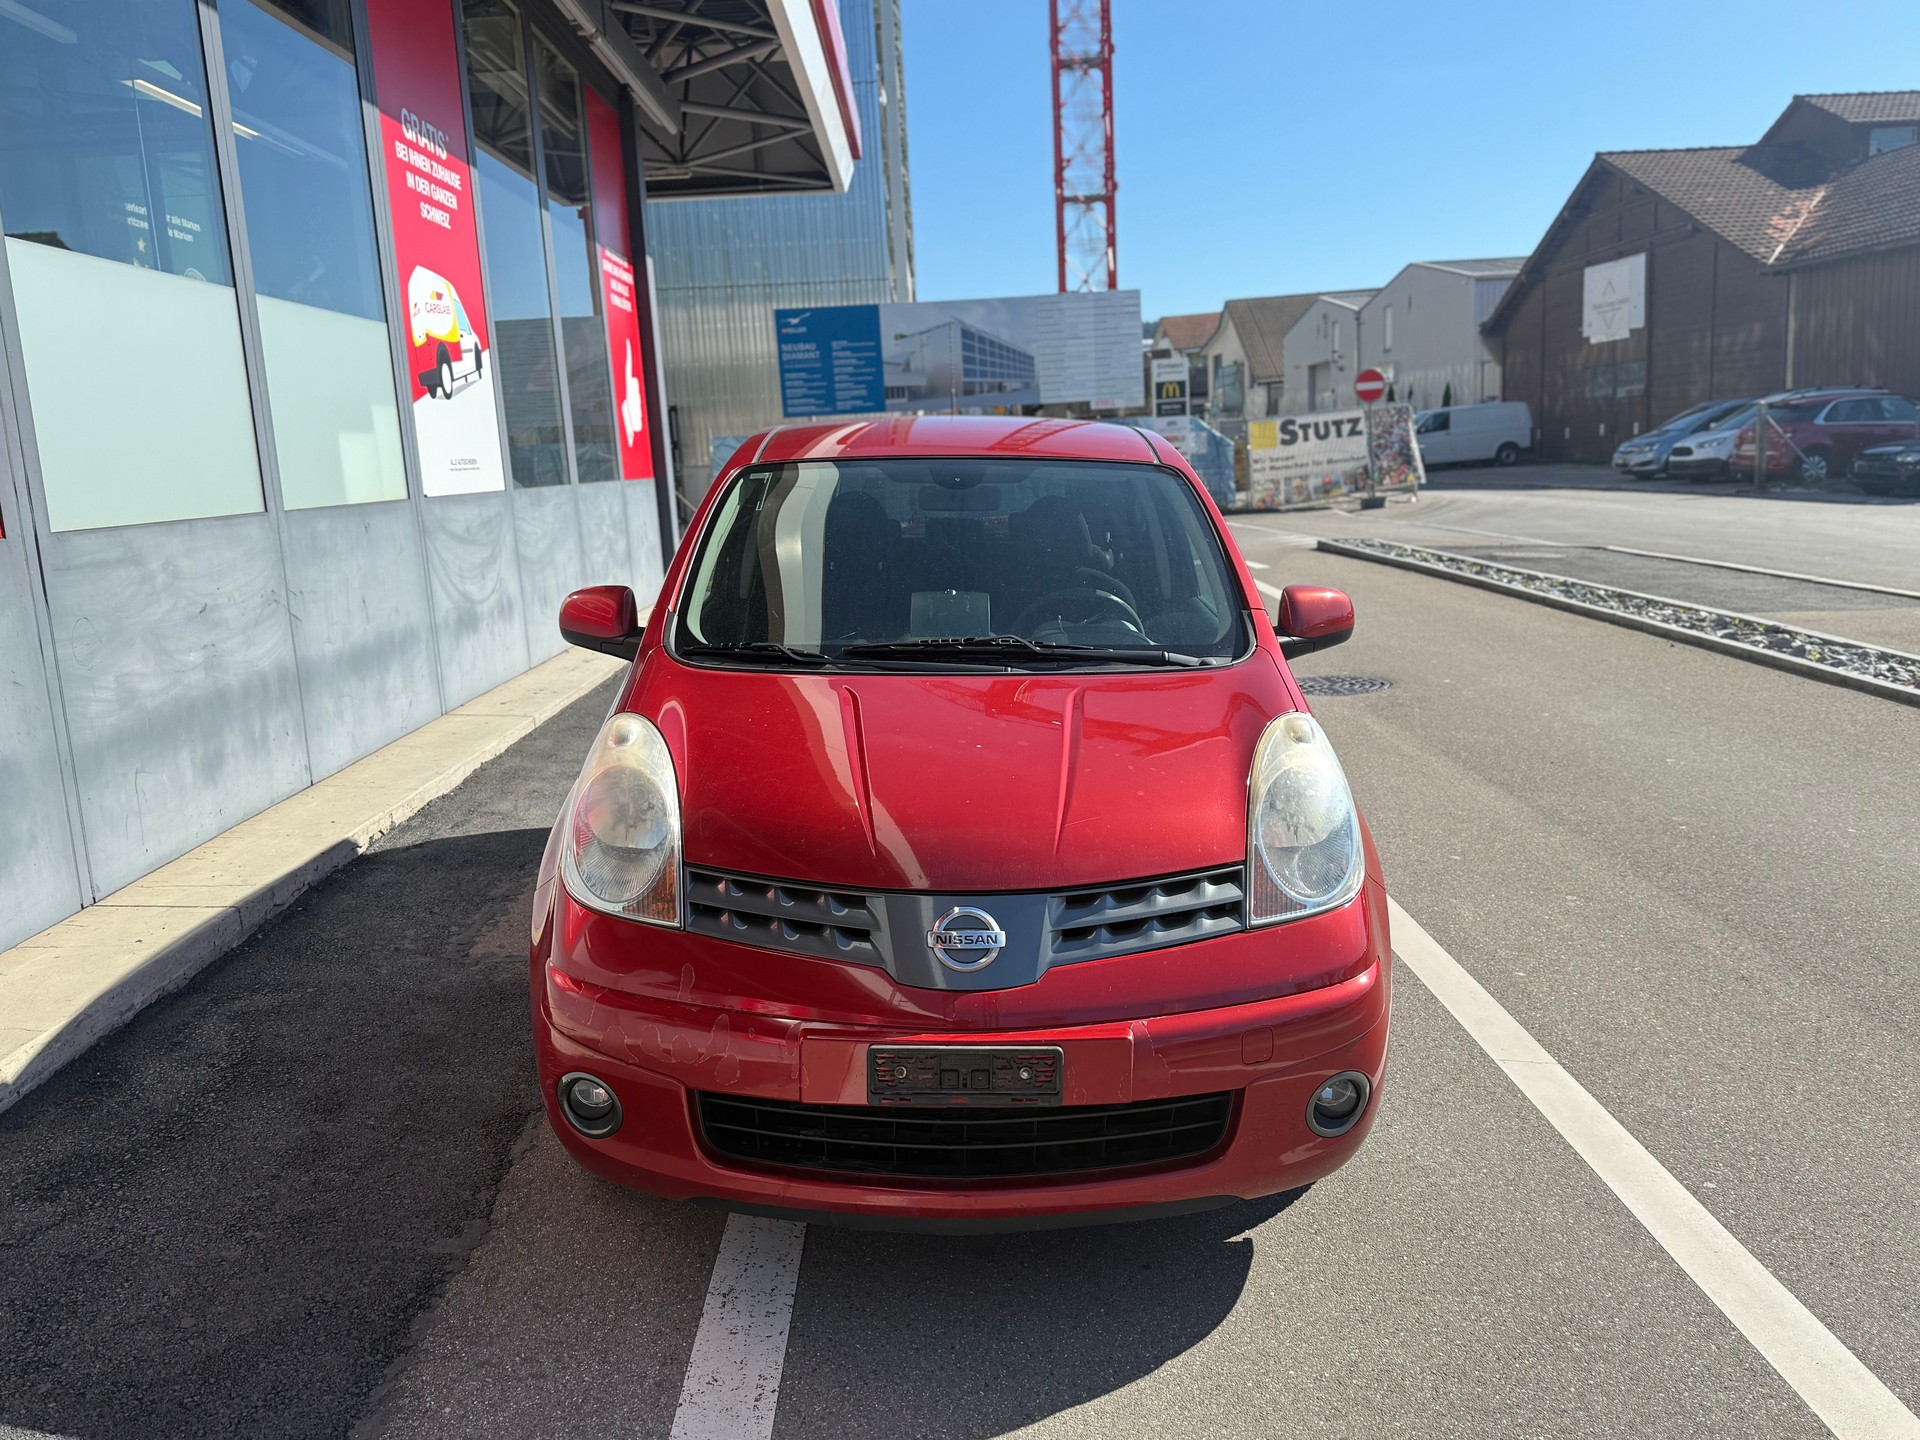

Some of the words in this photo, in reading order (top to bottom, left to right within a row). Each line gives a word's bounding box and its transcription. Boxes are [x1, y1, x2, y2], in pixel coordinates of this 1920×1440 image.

[395, 140, 408, 163] BEI
[409, 147, 431, 175] IHNEN
[431, 157, 462, 191] ZUHAUSE
[406, 170, 414, 189] IN
[416, 176, 430, 198] DER
[430, 182, 458, 211] GANZEN
[420, 201, 451, 229] SCHWEIZ
[1279, 417, 1363, 446] STUTZ
[935, 934, 998, 945] NISSAN
